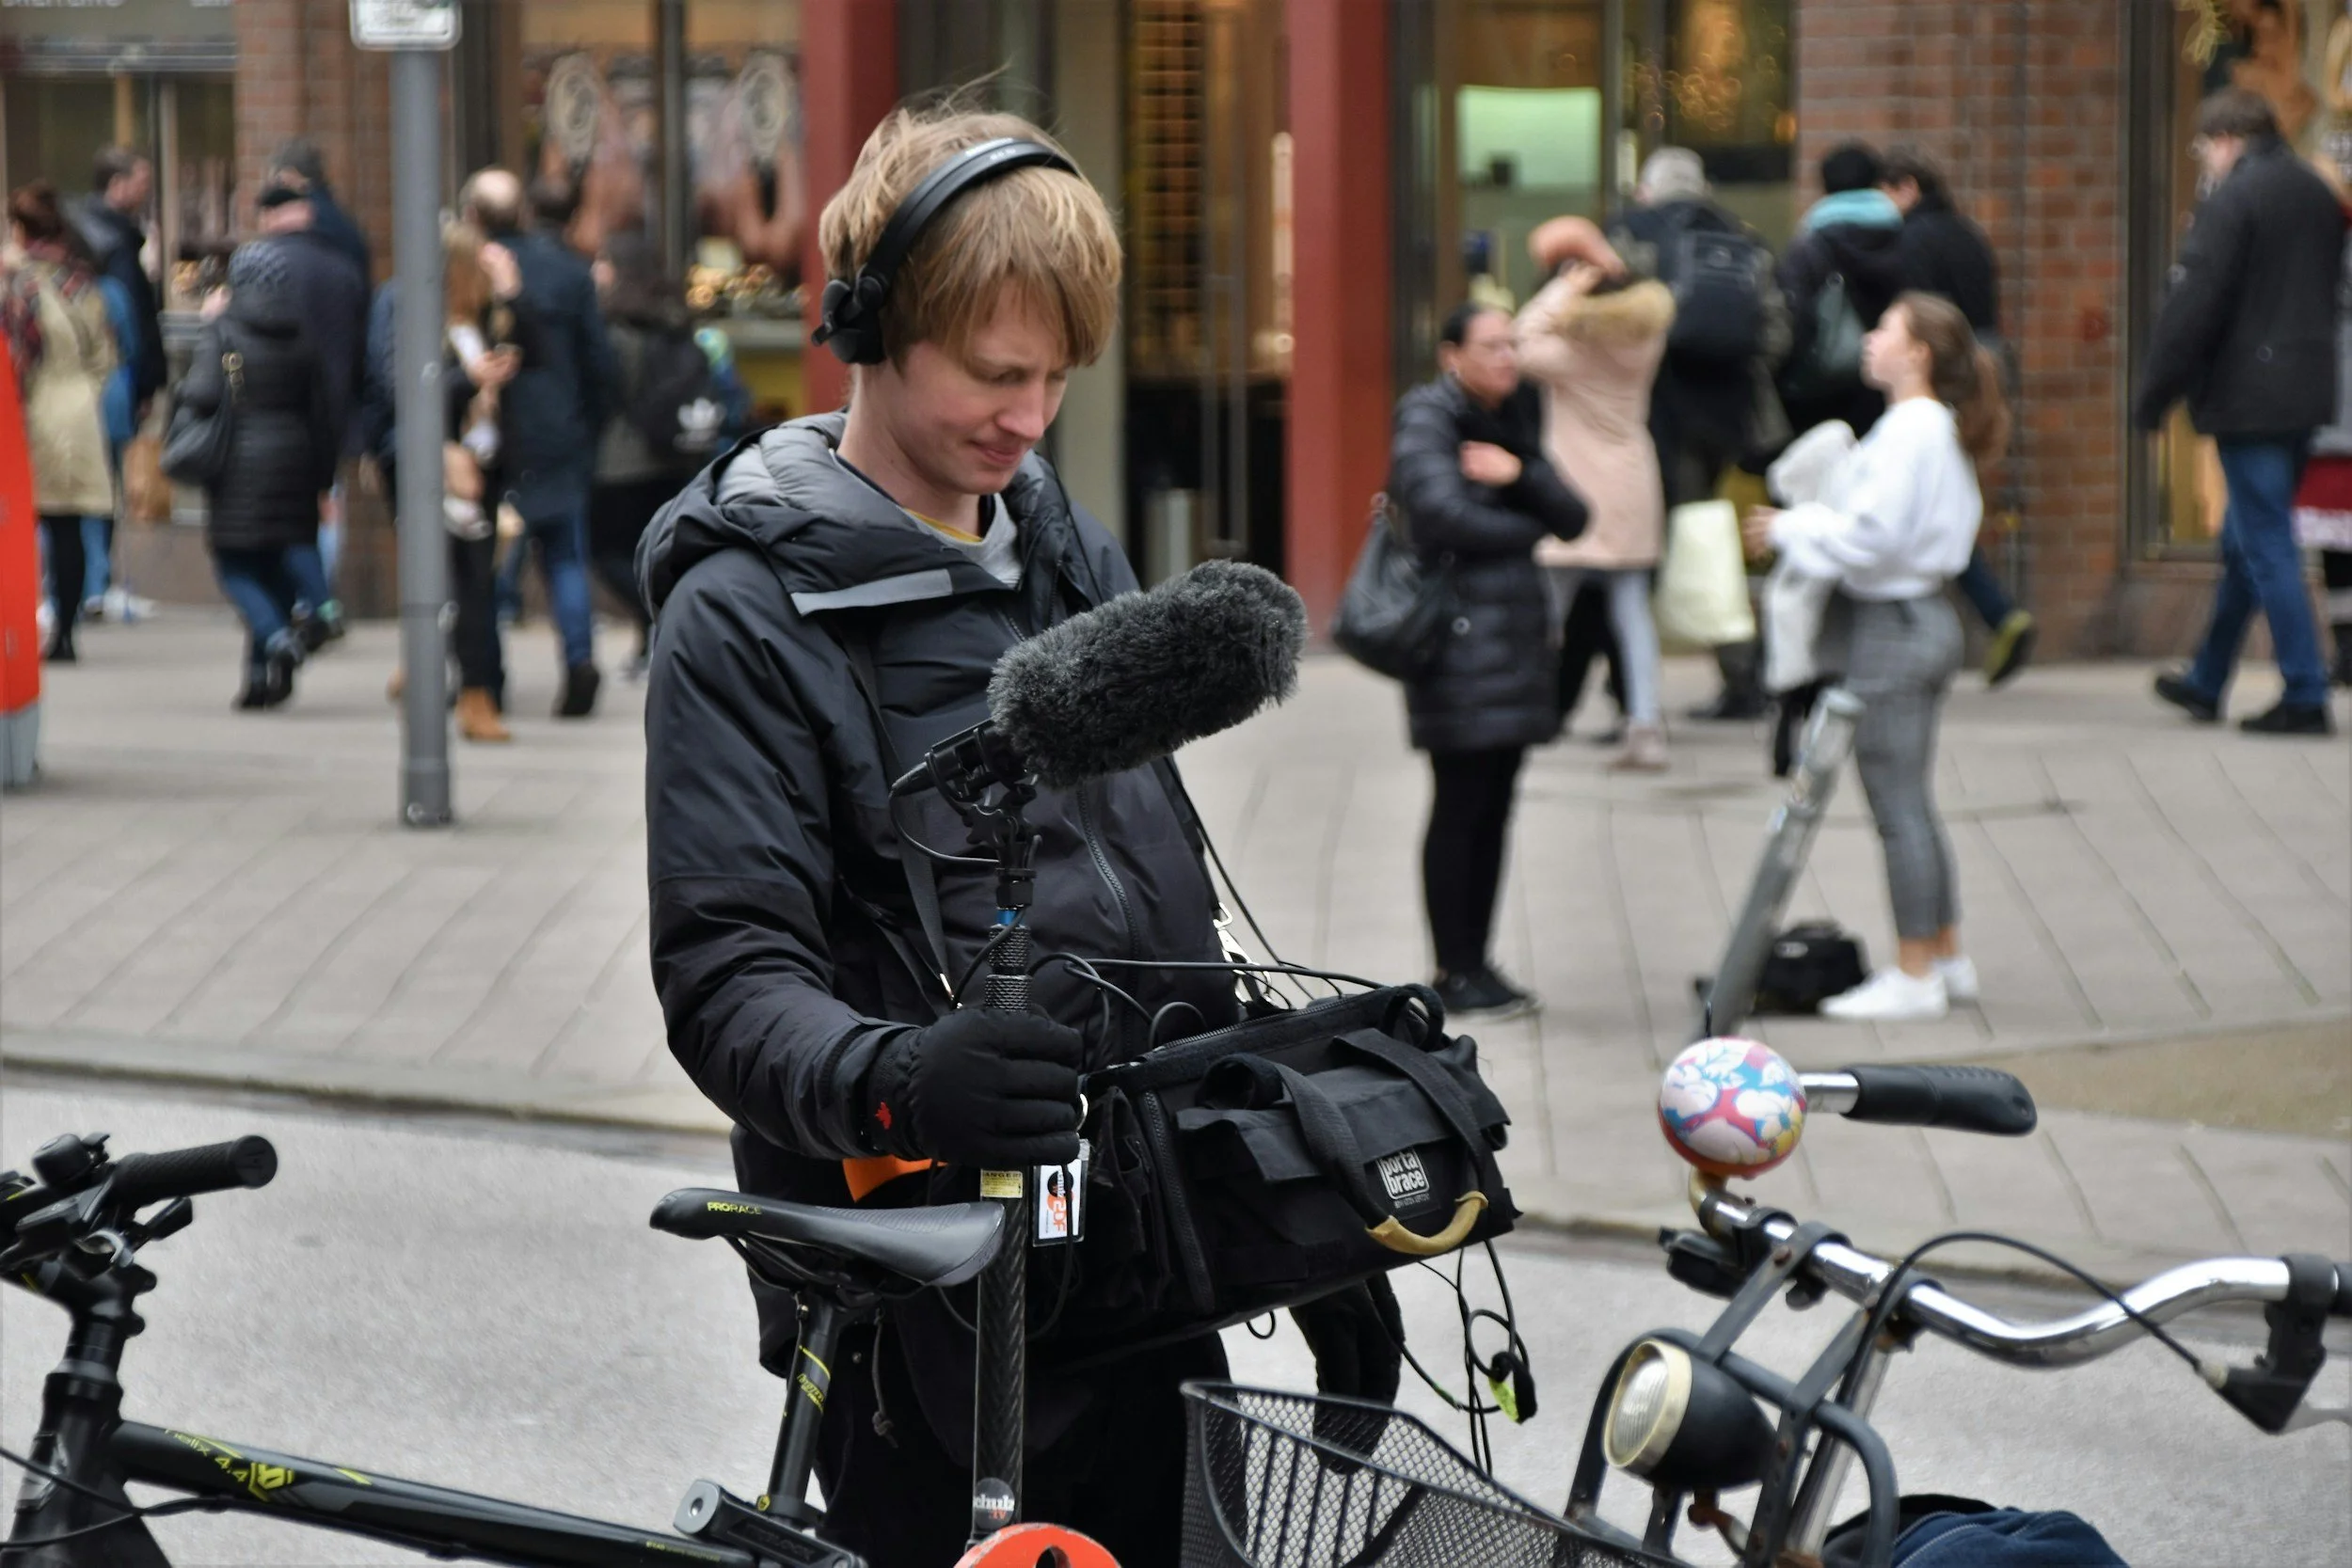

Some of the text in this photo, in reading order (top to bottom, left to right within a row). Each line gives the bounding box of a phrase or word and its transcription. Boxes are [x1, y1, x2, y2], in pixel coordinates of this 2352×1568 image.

[1379, 1151, 1419, 1176] porta
[1386, 1170, 1424, 1194] brace
[707, 1201, 762, 1214] PRORACE
[215, 1457, 248, 1482] 4.4
